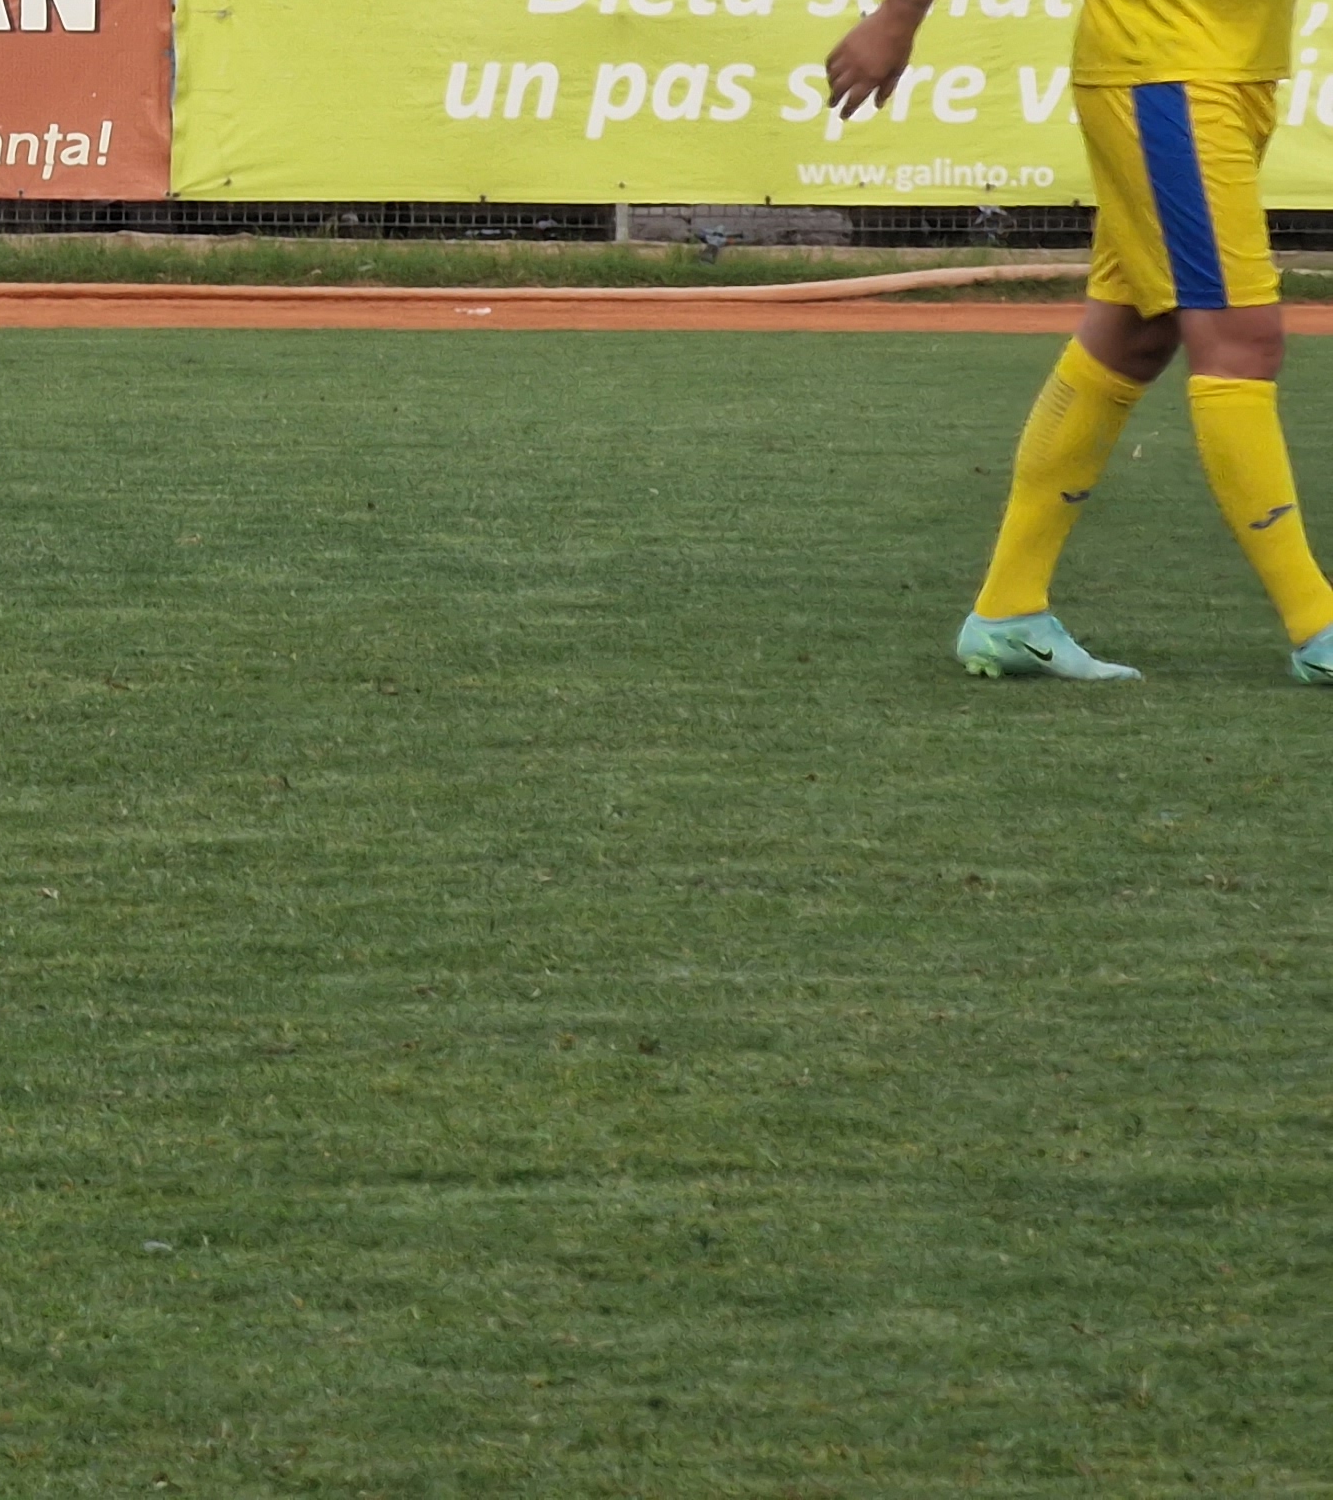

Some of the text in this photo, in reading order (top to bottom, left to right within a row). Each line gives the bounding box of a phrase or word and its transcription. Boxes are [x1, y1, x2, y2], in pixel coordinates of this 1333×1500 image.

[444, 61, 560, 121] un
[585, 62, 757, 140] pas
[796, 156, 1055, 193] www.galinto.ro
